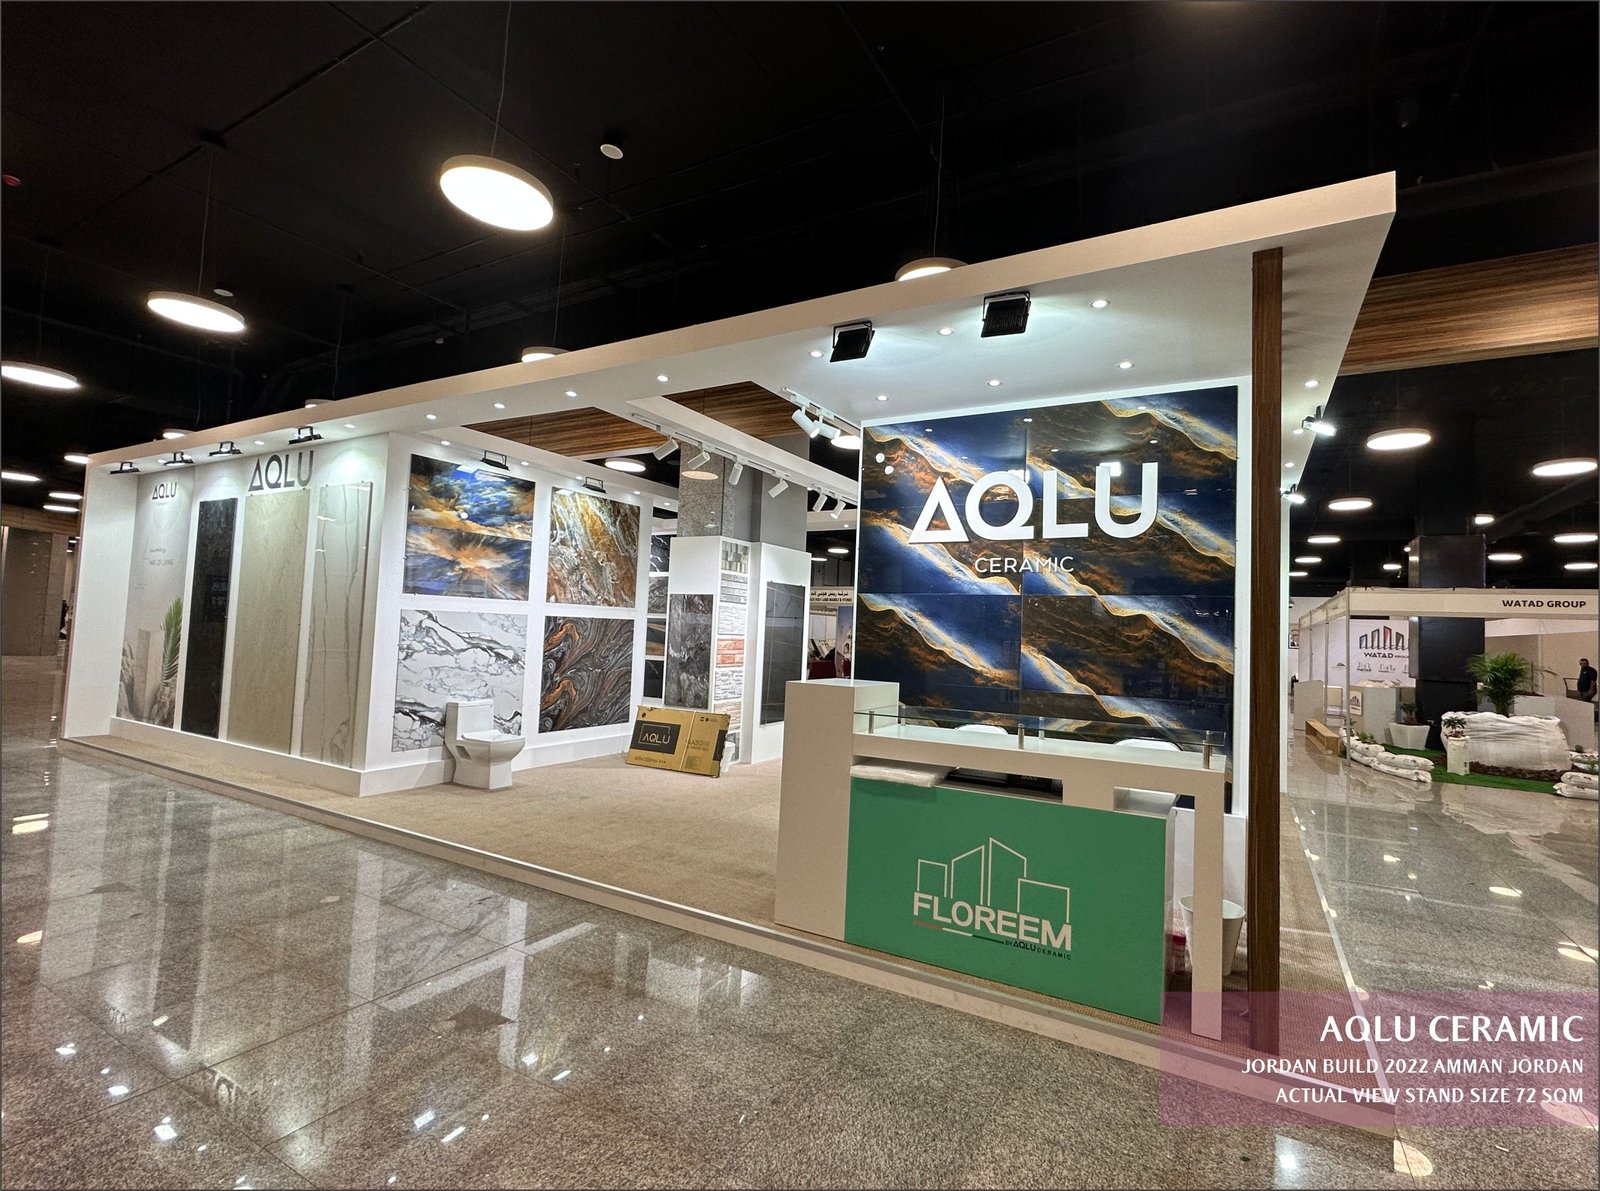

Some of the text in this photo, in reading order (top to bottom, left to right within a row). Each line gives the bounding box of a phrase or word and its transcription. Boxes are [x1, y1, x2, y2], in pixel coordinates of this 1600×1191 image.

[248, 450, 314, 492] AQLU
[152, 482, 178, 500] AQLU
[908, 462, 1159, 544] AQLU
[974, 555, 1075, 574] CERAMIC
[1502, 600, 1587, 608] WATAD GROUP
[642, 733, 671, 744] AQLU
[913, 892, 1073, 951] FLOREEM
[1013, 940, 1036, 952] AQLU
[1036, 947, 1072, 961] CERAMIC
